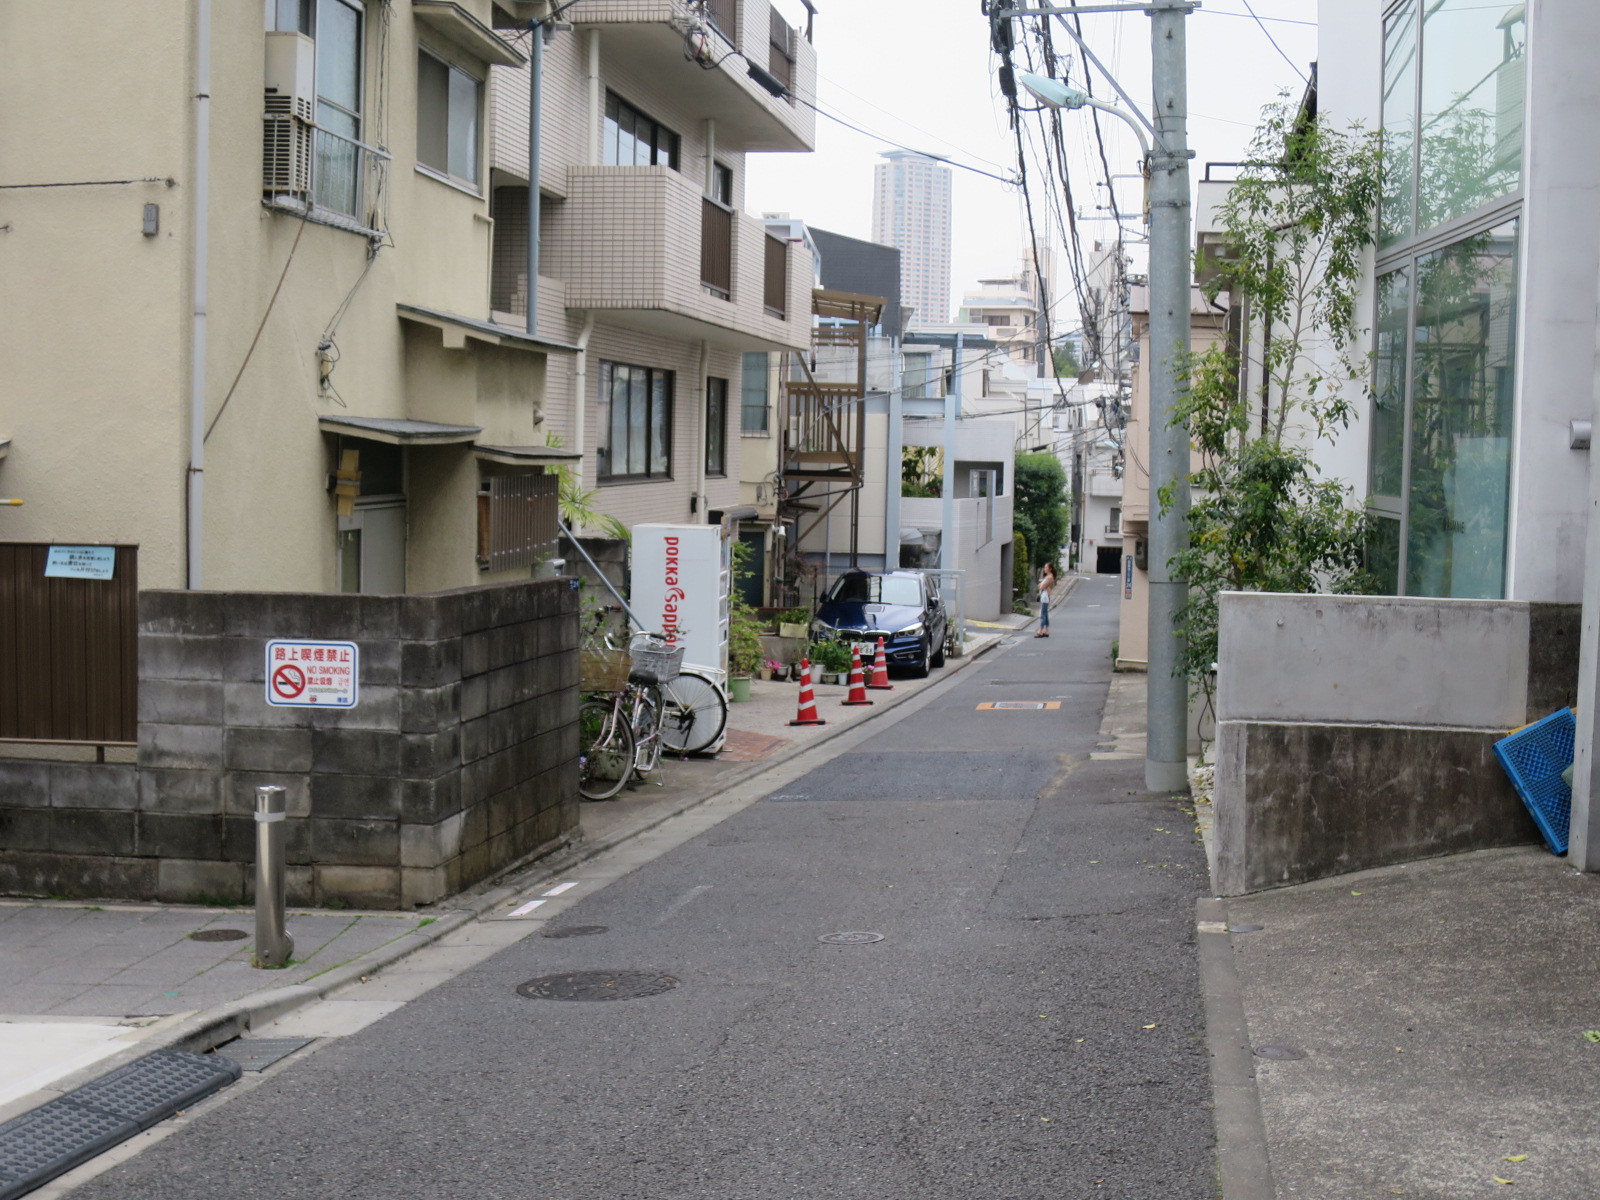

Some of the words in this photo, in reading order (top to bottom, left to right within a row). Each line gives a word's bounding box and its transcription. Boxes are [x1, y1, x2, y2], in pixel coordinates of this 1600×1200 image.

[275, 647, 350, 663] 路上喫煙禁止
[307, 666, 317, 674] NO
[319, 666, 350, 675] SMOKING
